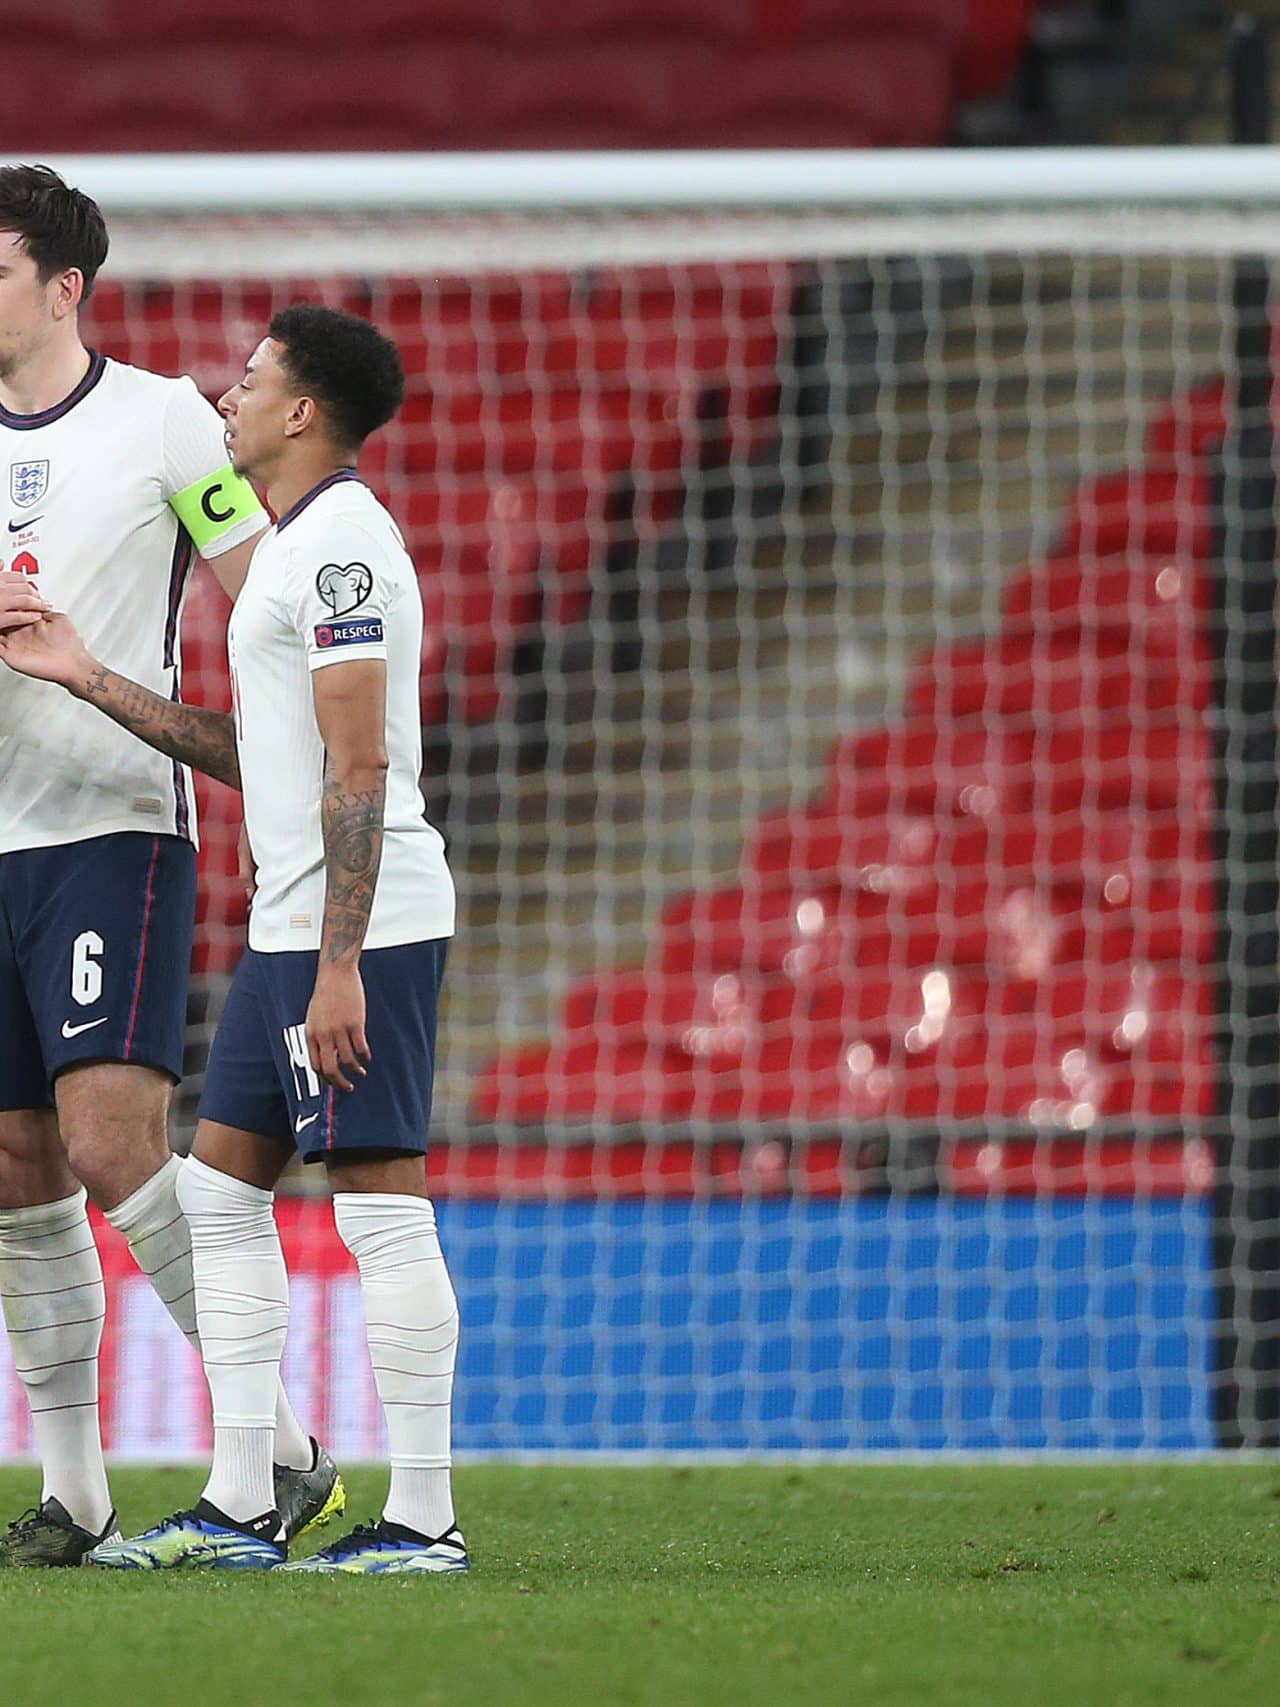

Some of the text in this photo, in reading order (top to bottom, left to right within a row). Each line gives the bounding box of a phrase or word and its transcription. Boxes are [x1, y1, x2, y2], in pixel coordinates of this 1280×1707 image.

[201, 484, 236, 523] C
[333, 624, 382, 641] RESPECT
[71, 930, 104, 1006] 6
